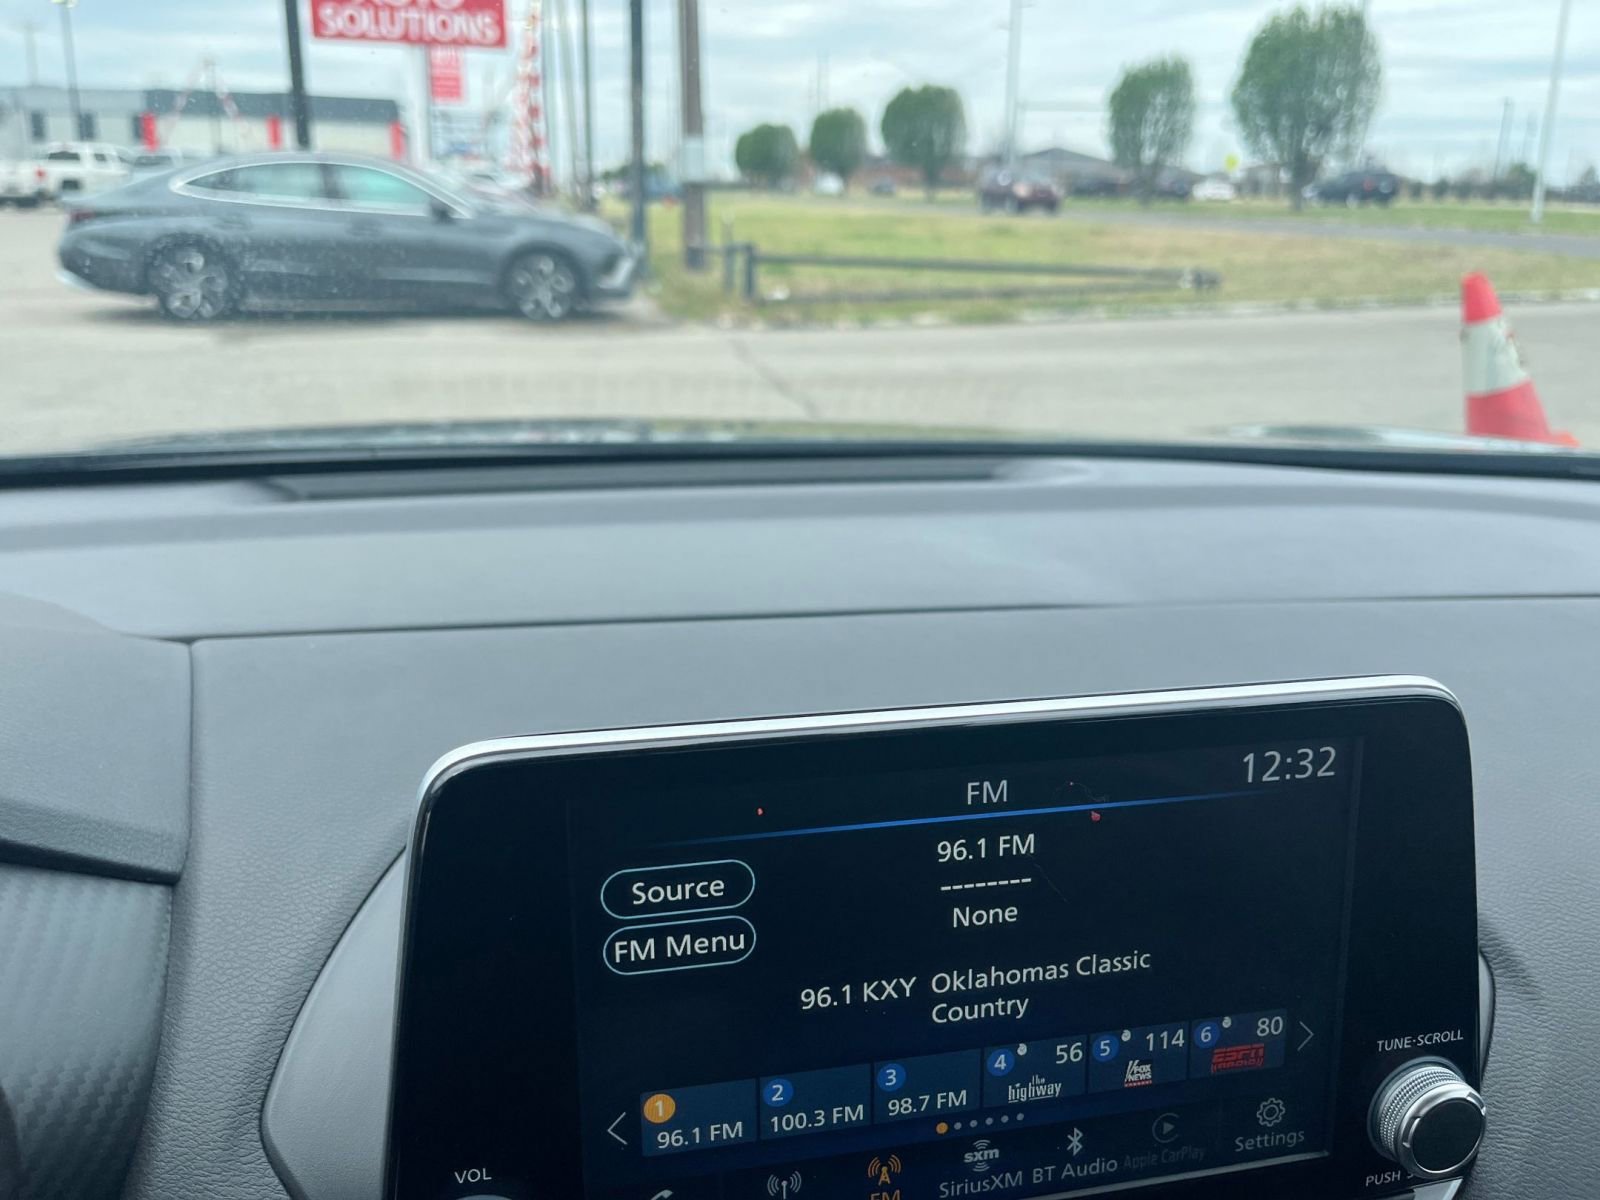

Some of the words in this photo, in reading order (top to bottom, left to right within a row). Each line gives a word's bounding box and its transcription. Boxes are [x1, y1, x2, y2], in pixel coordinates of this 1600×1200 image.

[319, 4, 500, 43] SOLUTIONS
[1242, 745, 1338, 785] 12:32
[966, 779, 1009, 805] FM
[936, 838, 988, 863] 96.1
[999, 833, 1036, 857] FM
[631, 878, 726, 905] Source
[952, 904, 1019, 928] None
[614, 937, 656, 963] FM
[666, 933, 746, 957] Menu
[931, 962, 1069, 993] Oklahomas
[1075, 949, 1152, 977] Classic
[800, 984, 851, 1010] 96.1
[863, 976, 917, 1003] KXY
[931, 998, 1030, 1024] Country
[1200, 1026, 1212, 1043] 6
[1256, 1016, 1284, 1037] 80
[1099, 1040, 1111, 1057] 5
[1146, 1029, 1185, 1052] 114
[994, 1054, 1007, 1071] 4
[1055, 1042, 1084, 1065] 56
[1212, 1043, 1265, 1063] ESPN
[885, 1069, 897, 1086] 3
[771, 1084, 784, 1102] 2
[888, 1095, 930, 1116] 98.7
[936, 1089, 968, 1110] FM
[1008, 1081, 1062, 1103] highway
[654, 1103, 664, 1118] 1
[770, 1112, 826, 1133] 100.3
[832, 1104, 865, 1125] FM
[656, 1127, 701, 1149] 96.1
[710, 1121, 743, 1142] FM
[1234, 1130, 1306, 1153] Settings
[963, 1149, 1000, 1164] sxm
[1123, 1150, 1158, 1170] Apple
[1160, 1145, 1205, 1164] CarPlay
[453, 1167, 492, 1183] VOL
[1032, 1166, 1056, 1184] BT
[1061, 1158, 1118, 1180] Audio
[1365, 1171, 1401, 1187] PUSH
[938, 1171, 1023, 1199] SiriusXM
